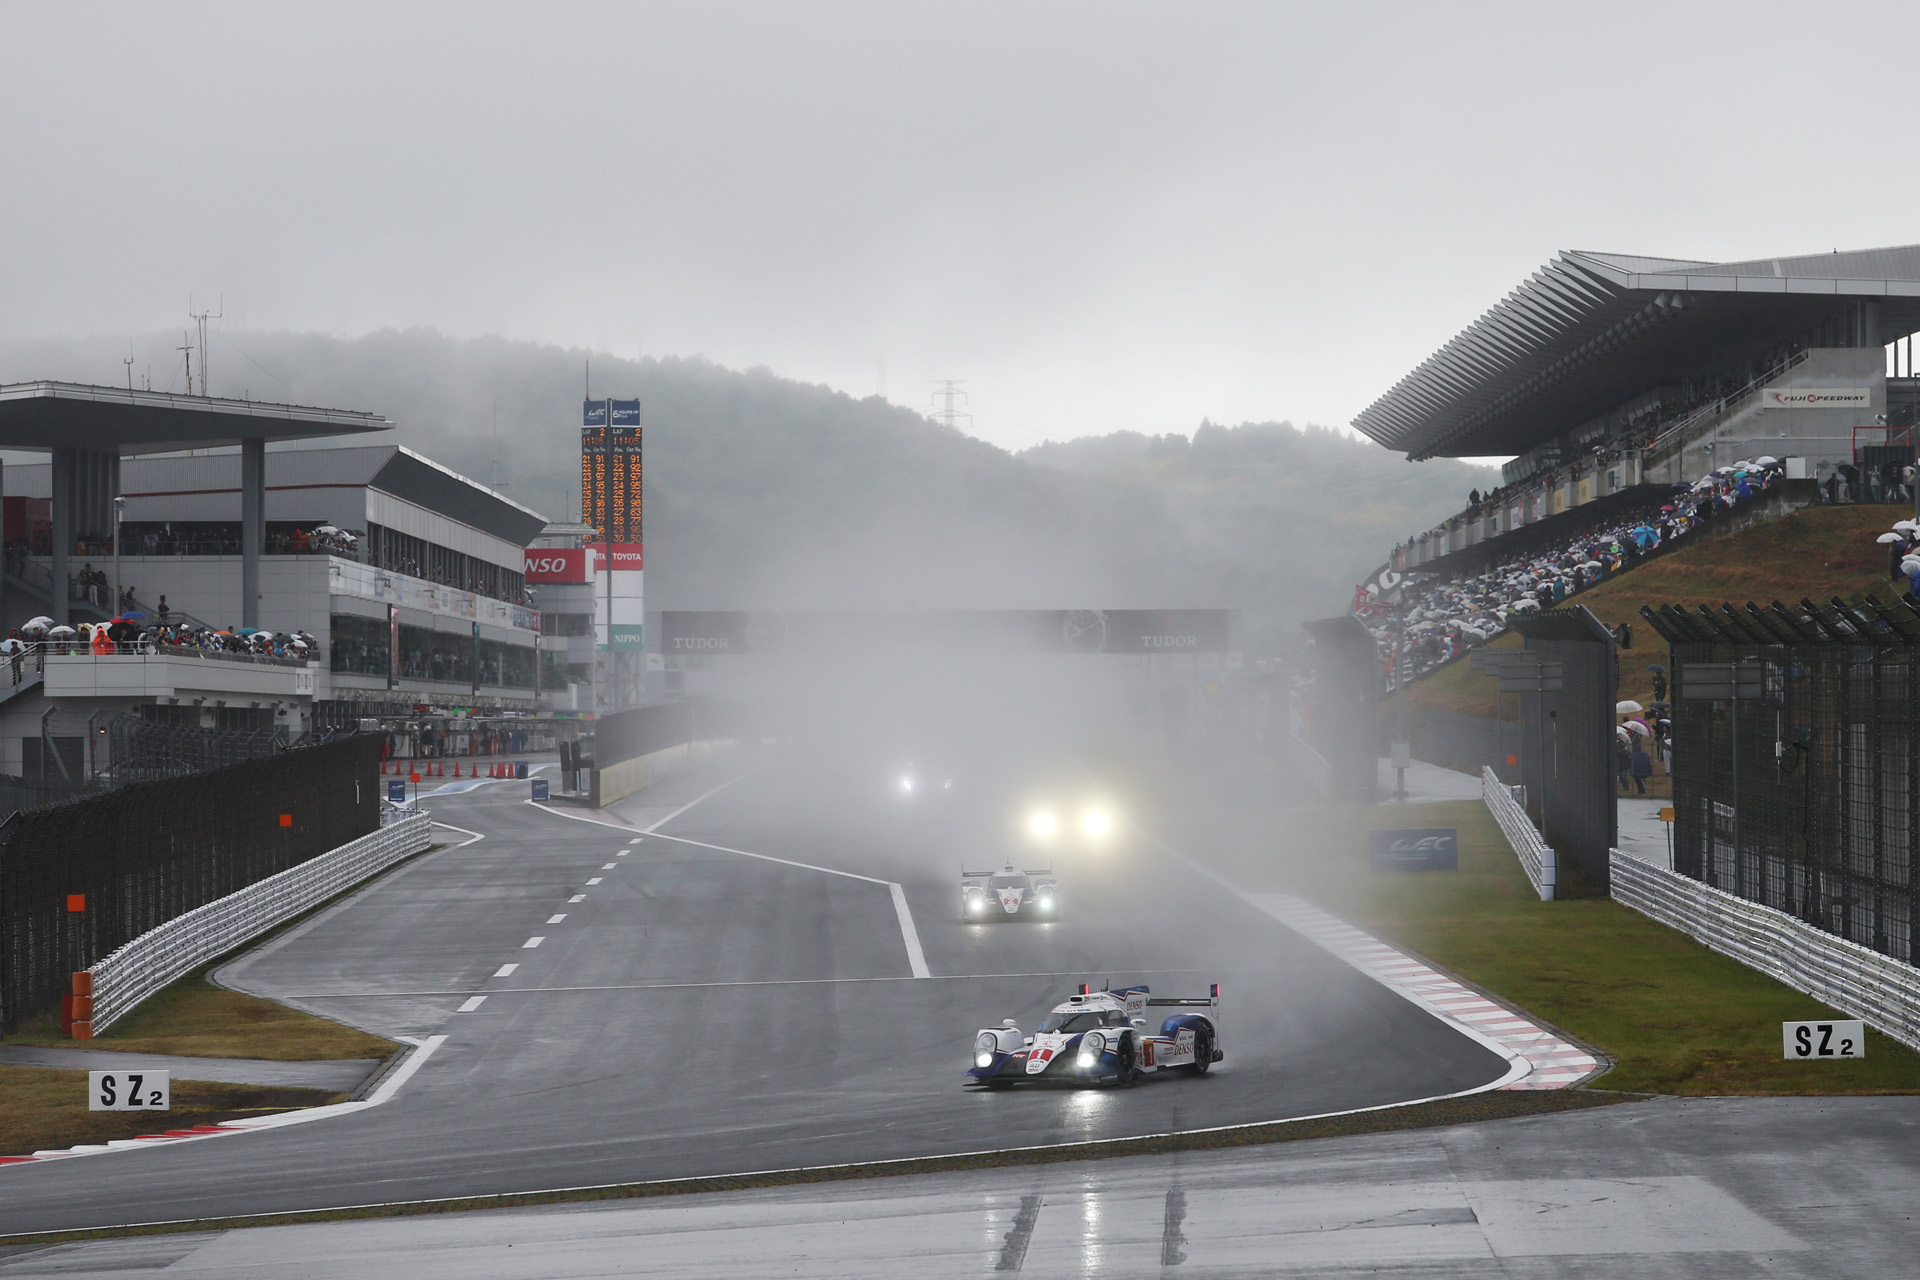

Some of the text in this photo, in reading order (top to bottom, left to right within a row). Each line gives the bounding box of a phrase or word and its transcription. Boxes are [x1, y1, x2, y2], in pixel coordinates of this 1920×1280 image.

[613, 410, 619, 418] 6
[600, 428, 605, 436] 2
[635, 428, 641, 436] 2
[613, 437, 640, 446] 11:05
[582, 455, 606, 463] 21 91
[613, 455, 641, 463] 21 91
[582, 464, 606, 472] 22 92
[613, 464, 641, 472] 22 92
[582, 472, 606, 480] 23 97
[613, 472, 641, 480] 23 97
[582, 481, 592, 490] 24
[613, 481, 624, 490] 24
[582, 490, 606, 498] 25 72
[613, 490, 641, 498] 25 72
[582, 499, 592, 507] 26
[613, 499, 624, 507] 26
[582, 508, 592, 516] 27
[613, 508, 624, 516] 27
[596, 516, 605, 525] 77
[613, 516, 641, 525] 28 77
[613, 534, 641, 542] 30 50
[612, 553, 642, 561] TOYOTA
[614, 634, 640, 643] NIPPO
[1142, 636, 1197, 648] TUDOR
[674, 637, 729, 649] TUDOR
[1126, 1000, 1143, 1011] DENSO
[1174, 1042, 1194, 1056] DENSO
[1036, 1048, 1045, 1059] 1
